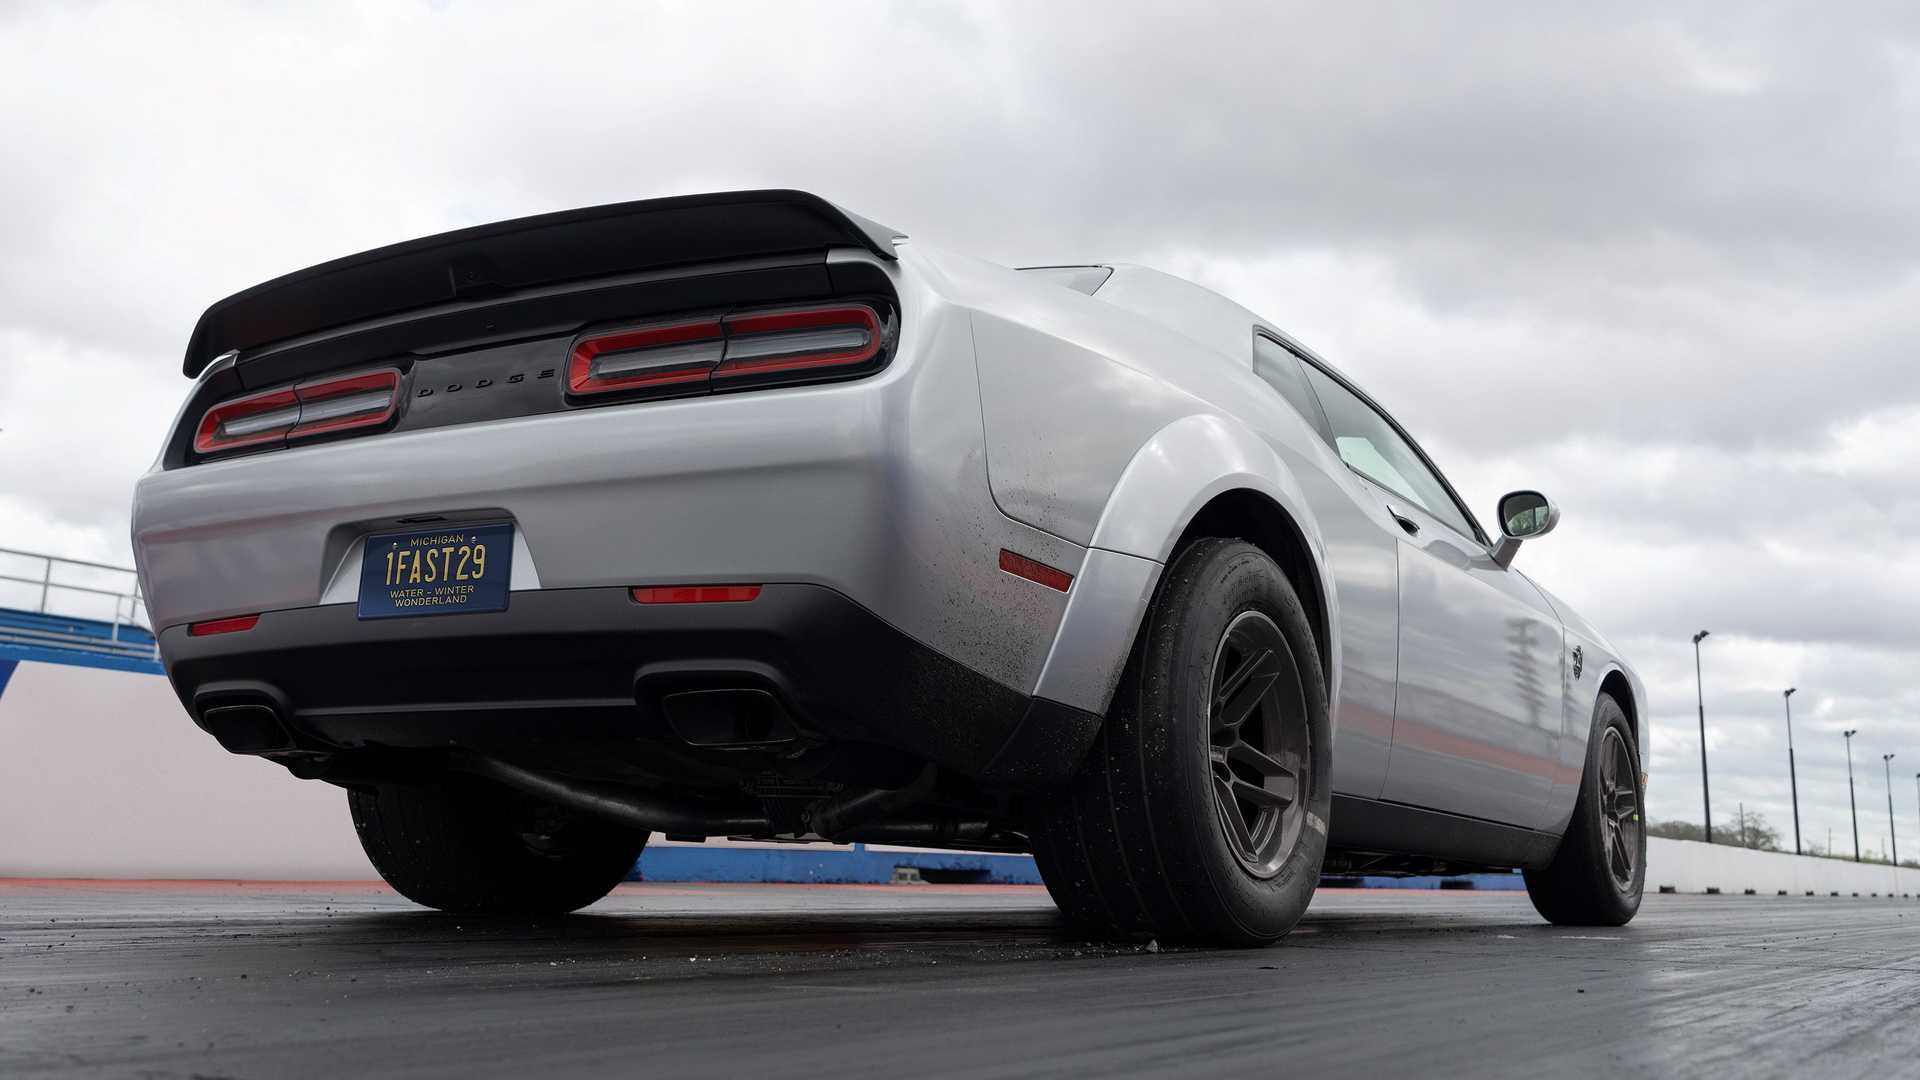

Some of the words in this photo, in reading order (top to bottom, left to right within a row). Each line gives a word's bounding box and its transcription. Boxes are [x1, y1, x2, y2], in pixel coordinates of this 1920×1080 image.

[417, 369, 555, 397] DODGE
[410, 534, 464, 547] MICHIGAN
[385, 544, 486, 586] 1FAST29
[390, 588, 424, 599] WATER
[434, 585, 474, 596] WINTER
[395, 595, 467, 608] WONDERLAND
